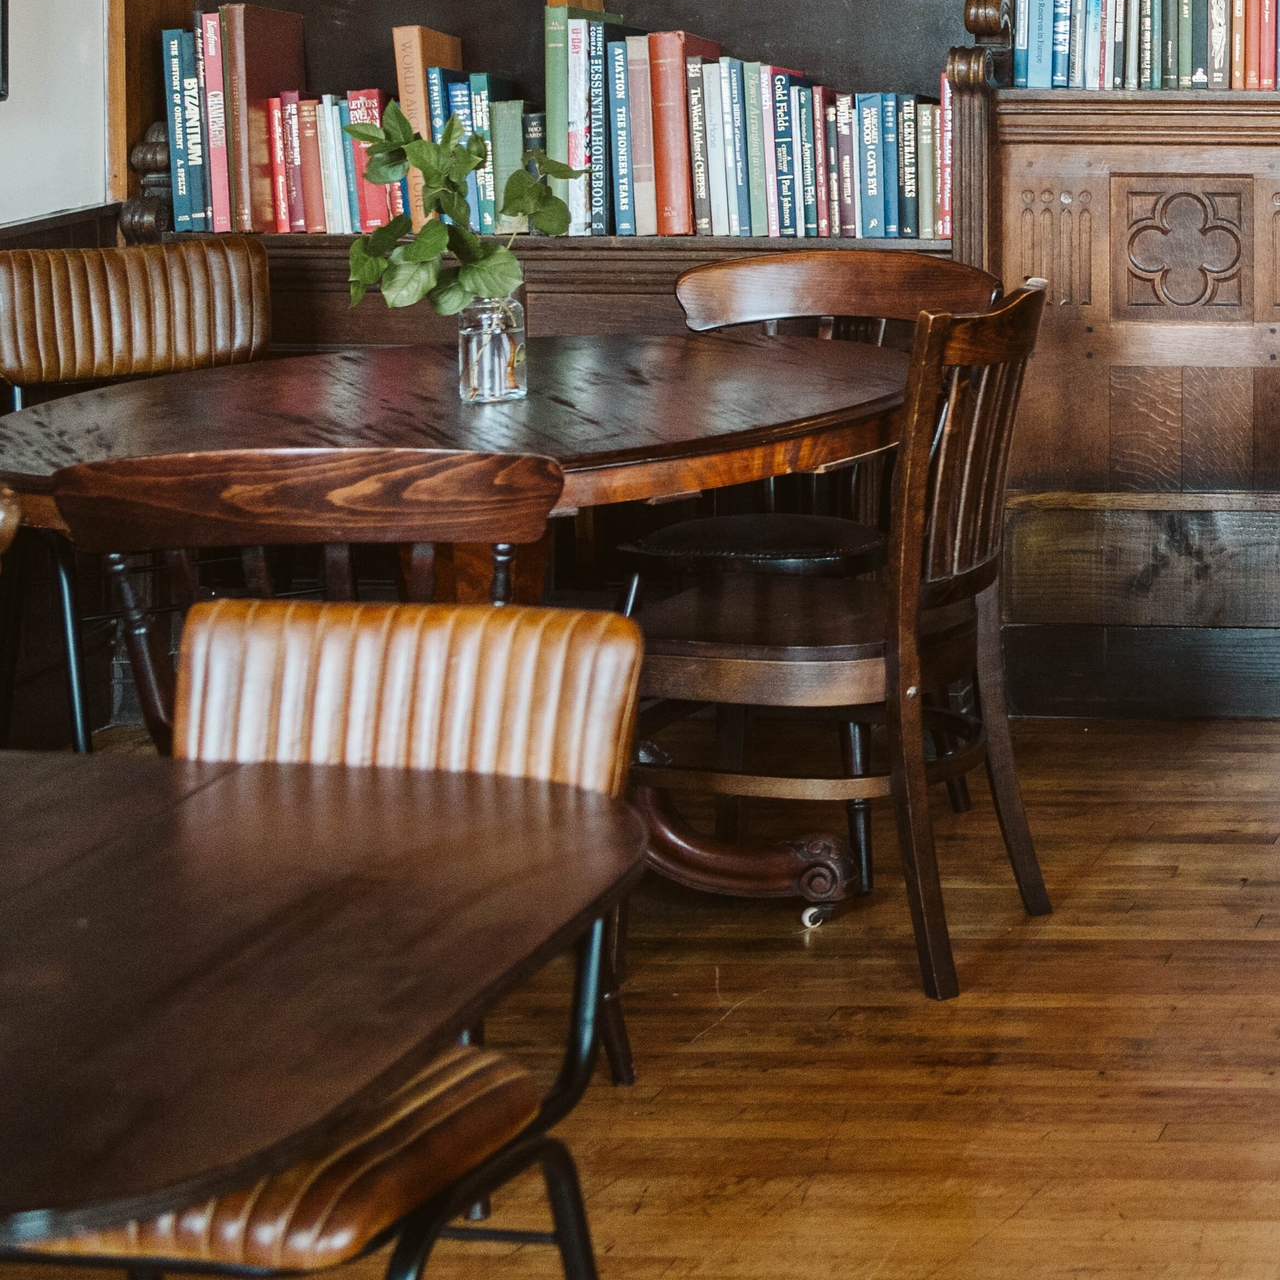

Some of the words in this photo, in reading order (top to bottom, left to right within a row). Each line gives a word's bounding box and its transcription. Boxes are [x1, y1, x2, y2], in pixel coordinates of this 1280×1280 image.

[1037, 3, 1045, 31] Reserves
[171, 40, 179, 56] THE
[1036, 41, 1044, 63] Europe
[172, 58, 181, 92] HISTORY
[614, 47, 626, 99] AVIATION
[775, 75, 786, 99] Gold
[174, 94, 182, 105] OF
[762, 73, 771, 109] swatch
[174, 107, 183, 149] ORNAMENT
[184, 78, 202, 165] BYZANTIUM
[209, 91, 224, 147] CHAMPAGNE
[617, 106, 626, 127] THE
[776, 102, 787, 131] Fields
[177, 159, 185, 167] A.
[617, 130, 628, 174] PIONEER
[177, 169, 186, 195] SPELTZ
[618, 178, 628, 210] YEARS
